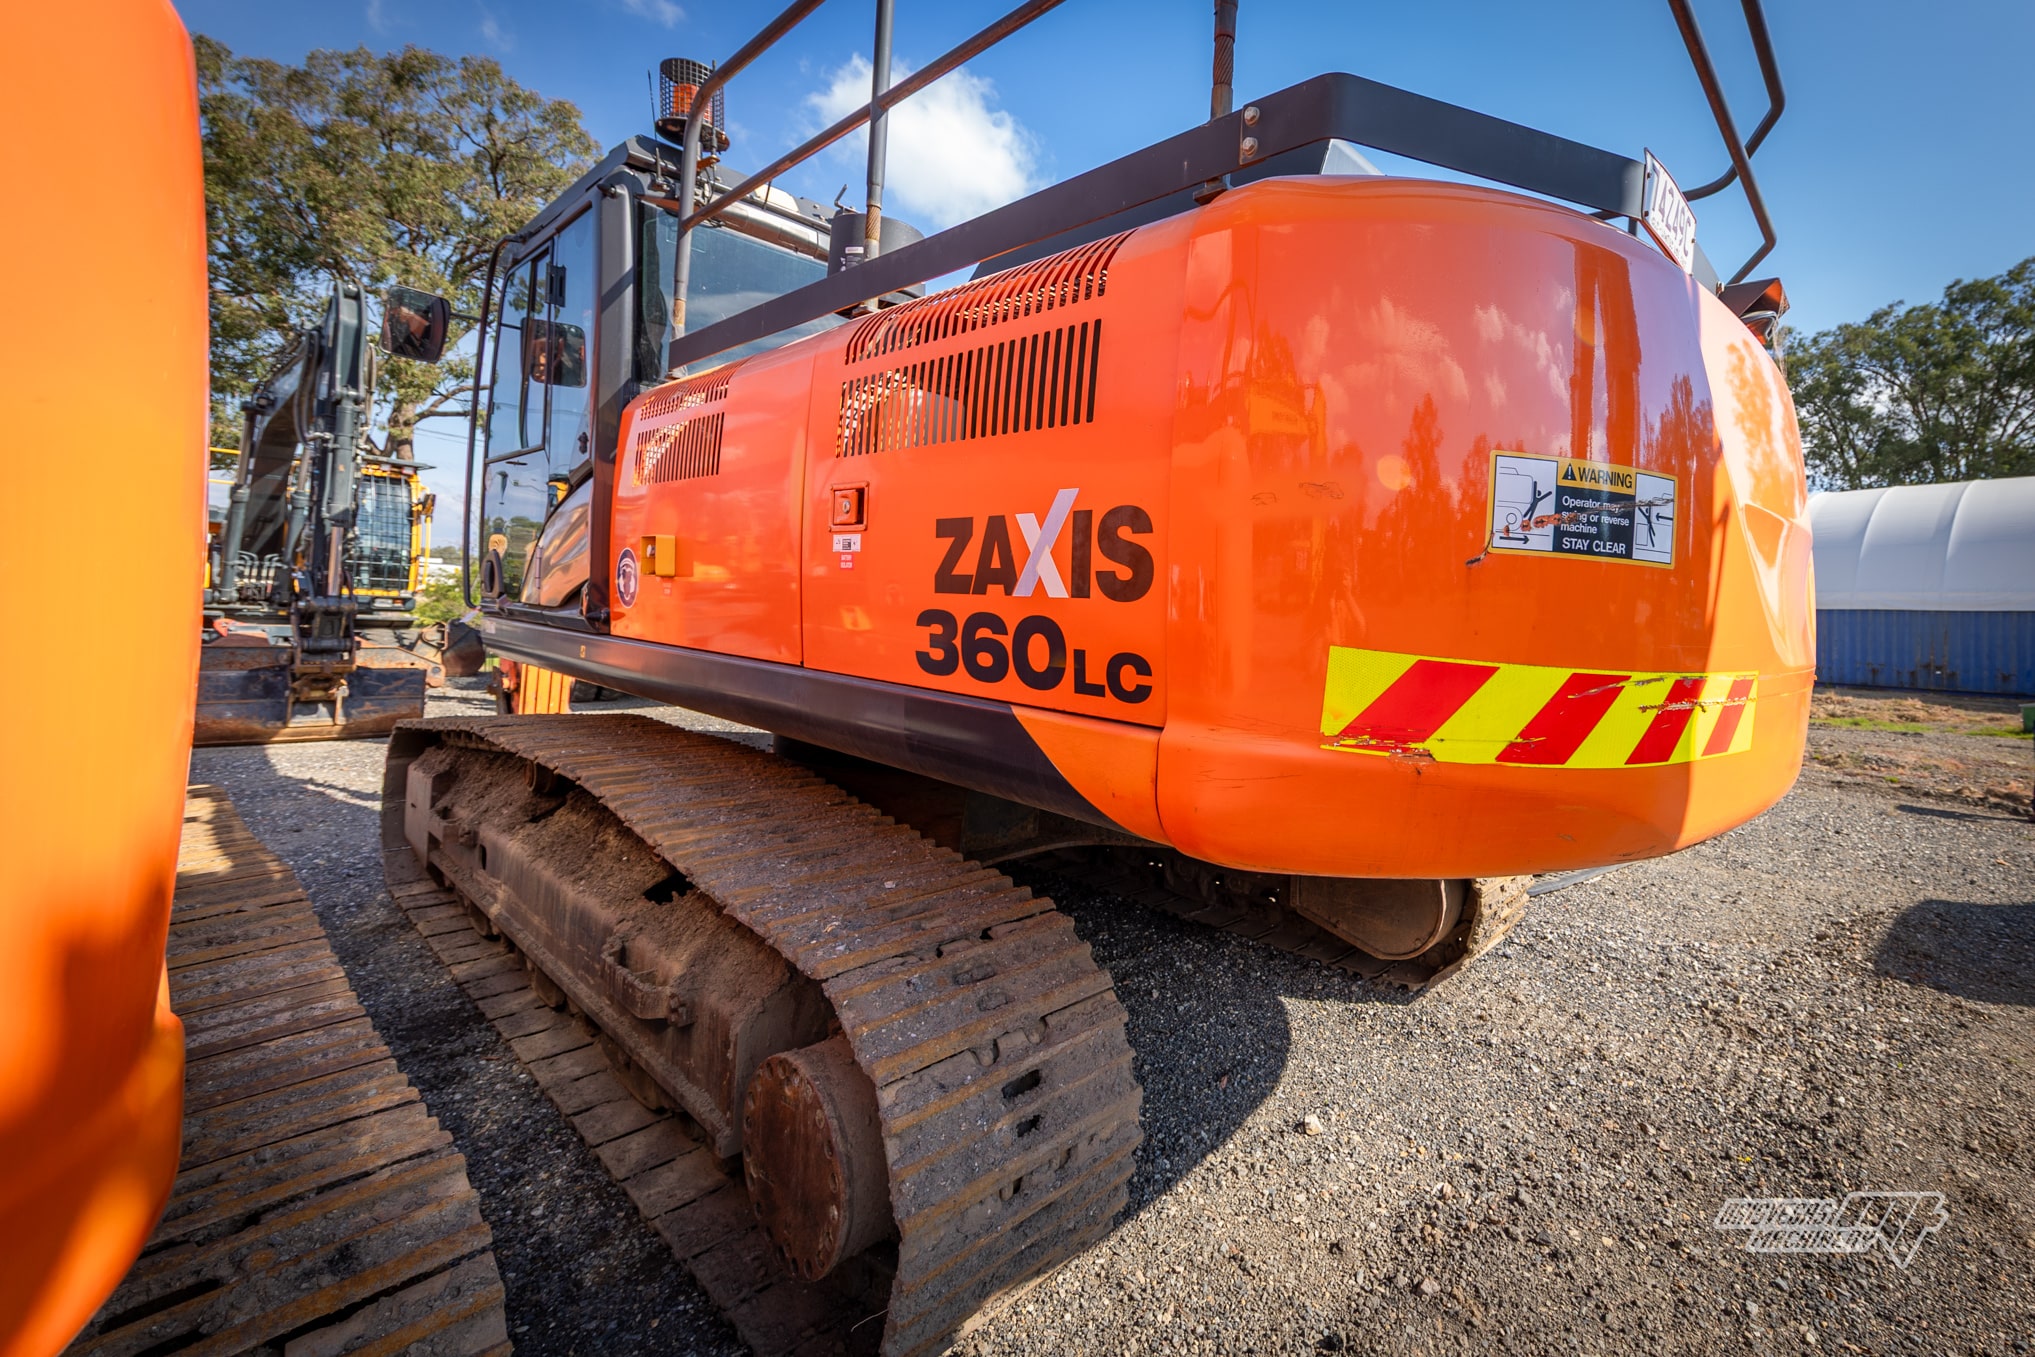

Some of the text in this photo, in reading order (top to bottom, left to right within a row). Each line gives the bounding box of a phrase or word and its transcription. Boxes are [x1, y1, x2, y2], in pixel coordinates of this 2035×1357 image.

[1652, 161, 1692, 258] 74249C
[1578, 466, 1633, 489] WARNING
[1562, 495, 1600, 509] Operator
[1561, 510, 1630, 527] sng or reverse
[1560, 523, 1598, 534] machine
[934, 487, 1154, 603] ZAXIS
[1562, 537, 1626, 555] STAY CLEAR
